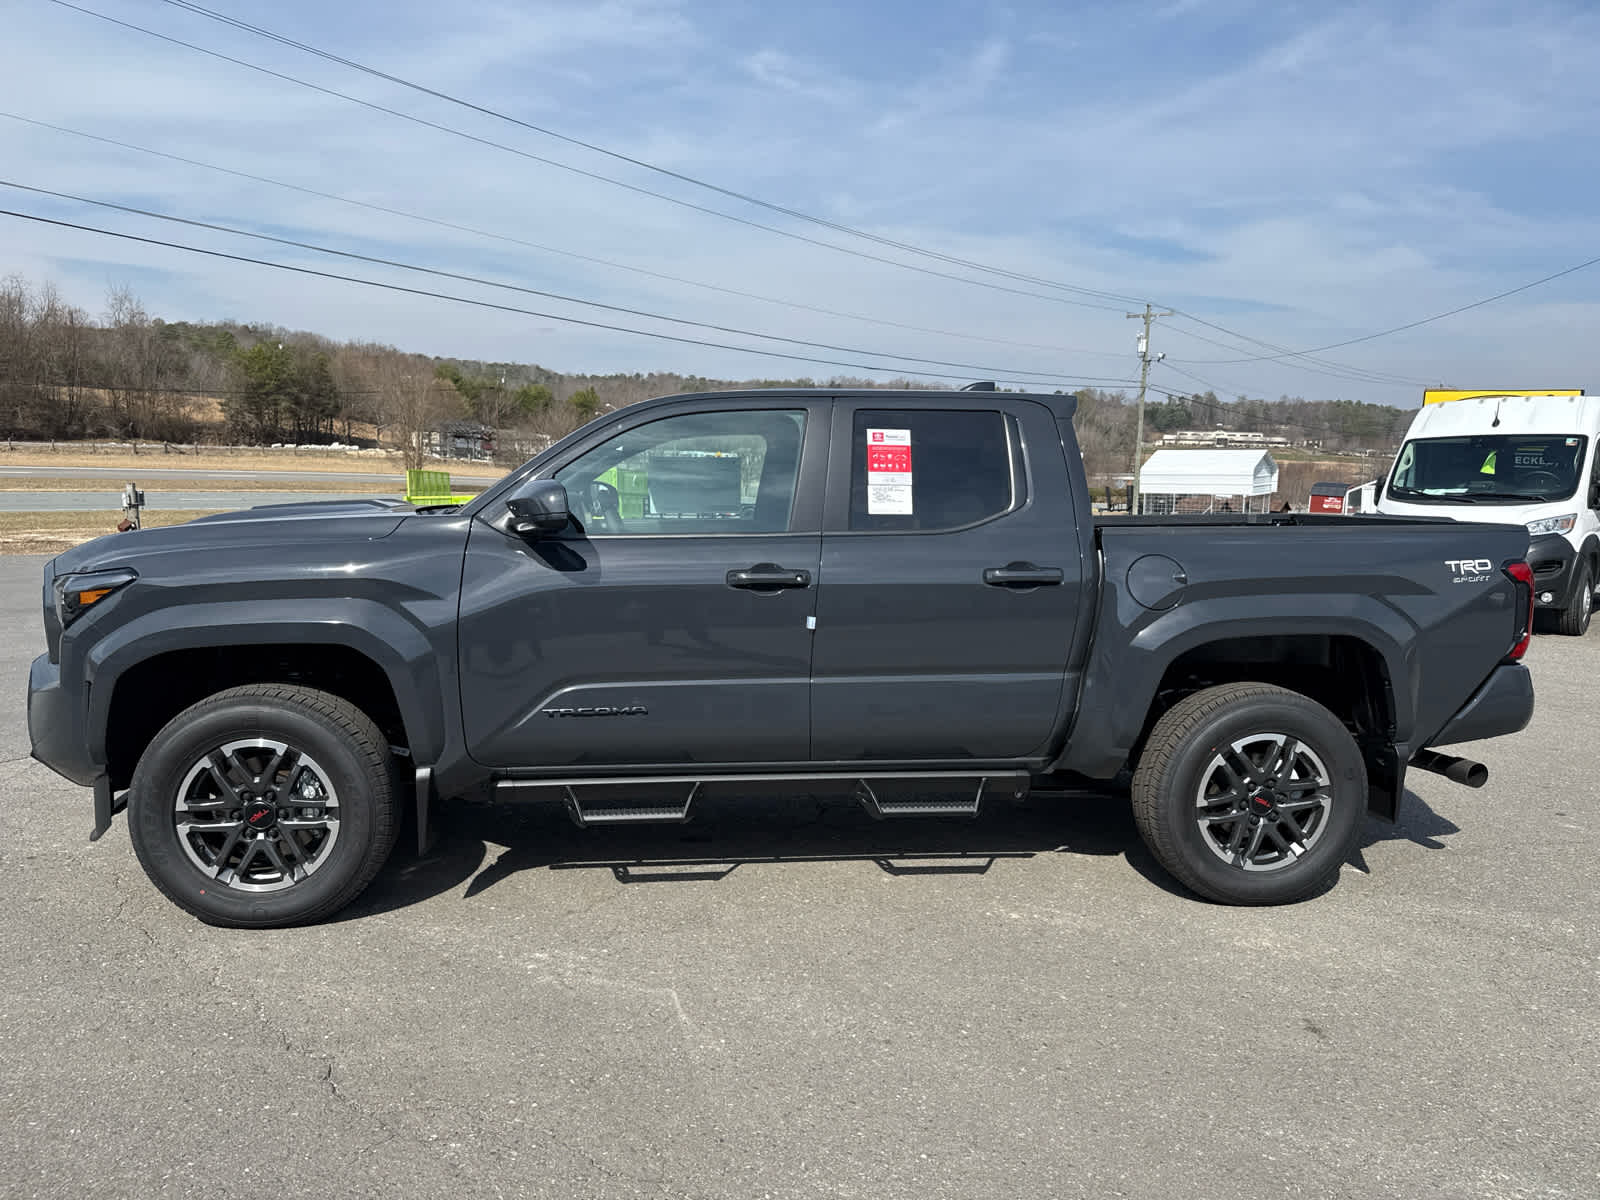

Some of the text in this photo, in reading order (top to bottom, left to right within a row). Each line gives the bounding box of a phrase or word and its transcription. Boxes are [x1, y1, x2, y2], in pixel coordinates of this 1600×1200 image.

[1444, 559, 1492, 575] TRD
[1453, 575, 1491, 583] SPORT
[541, 706, 648, 718] TACOMA
